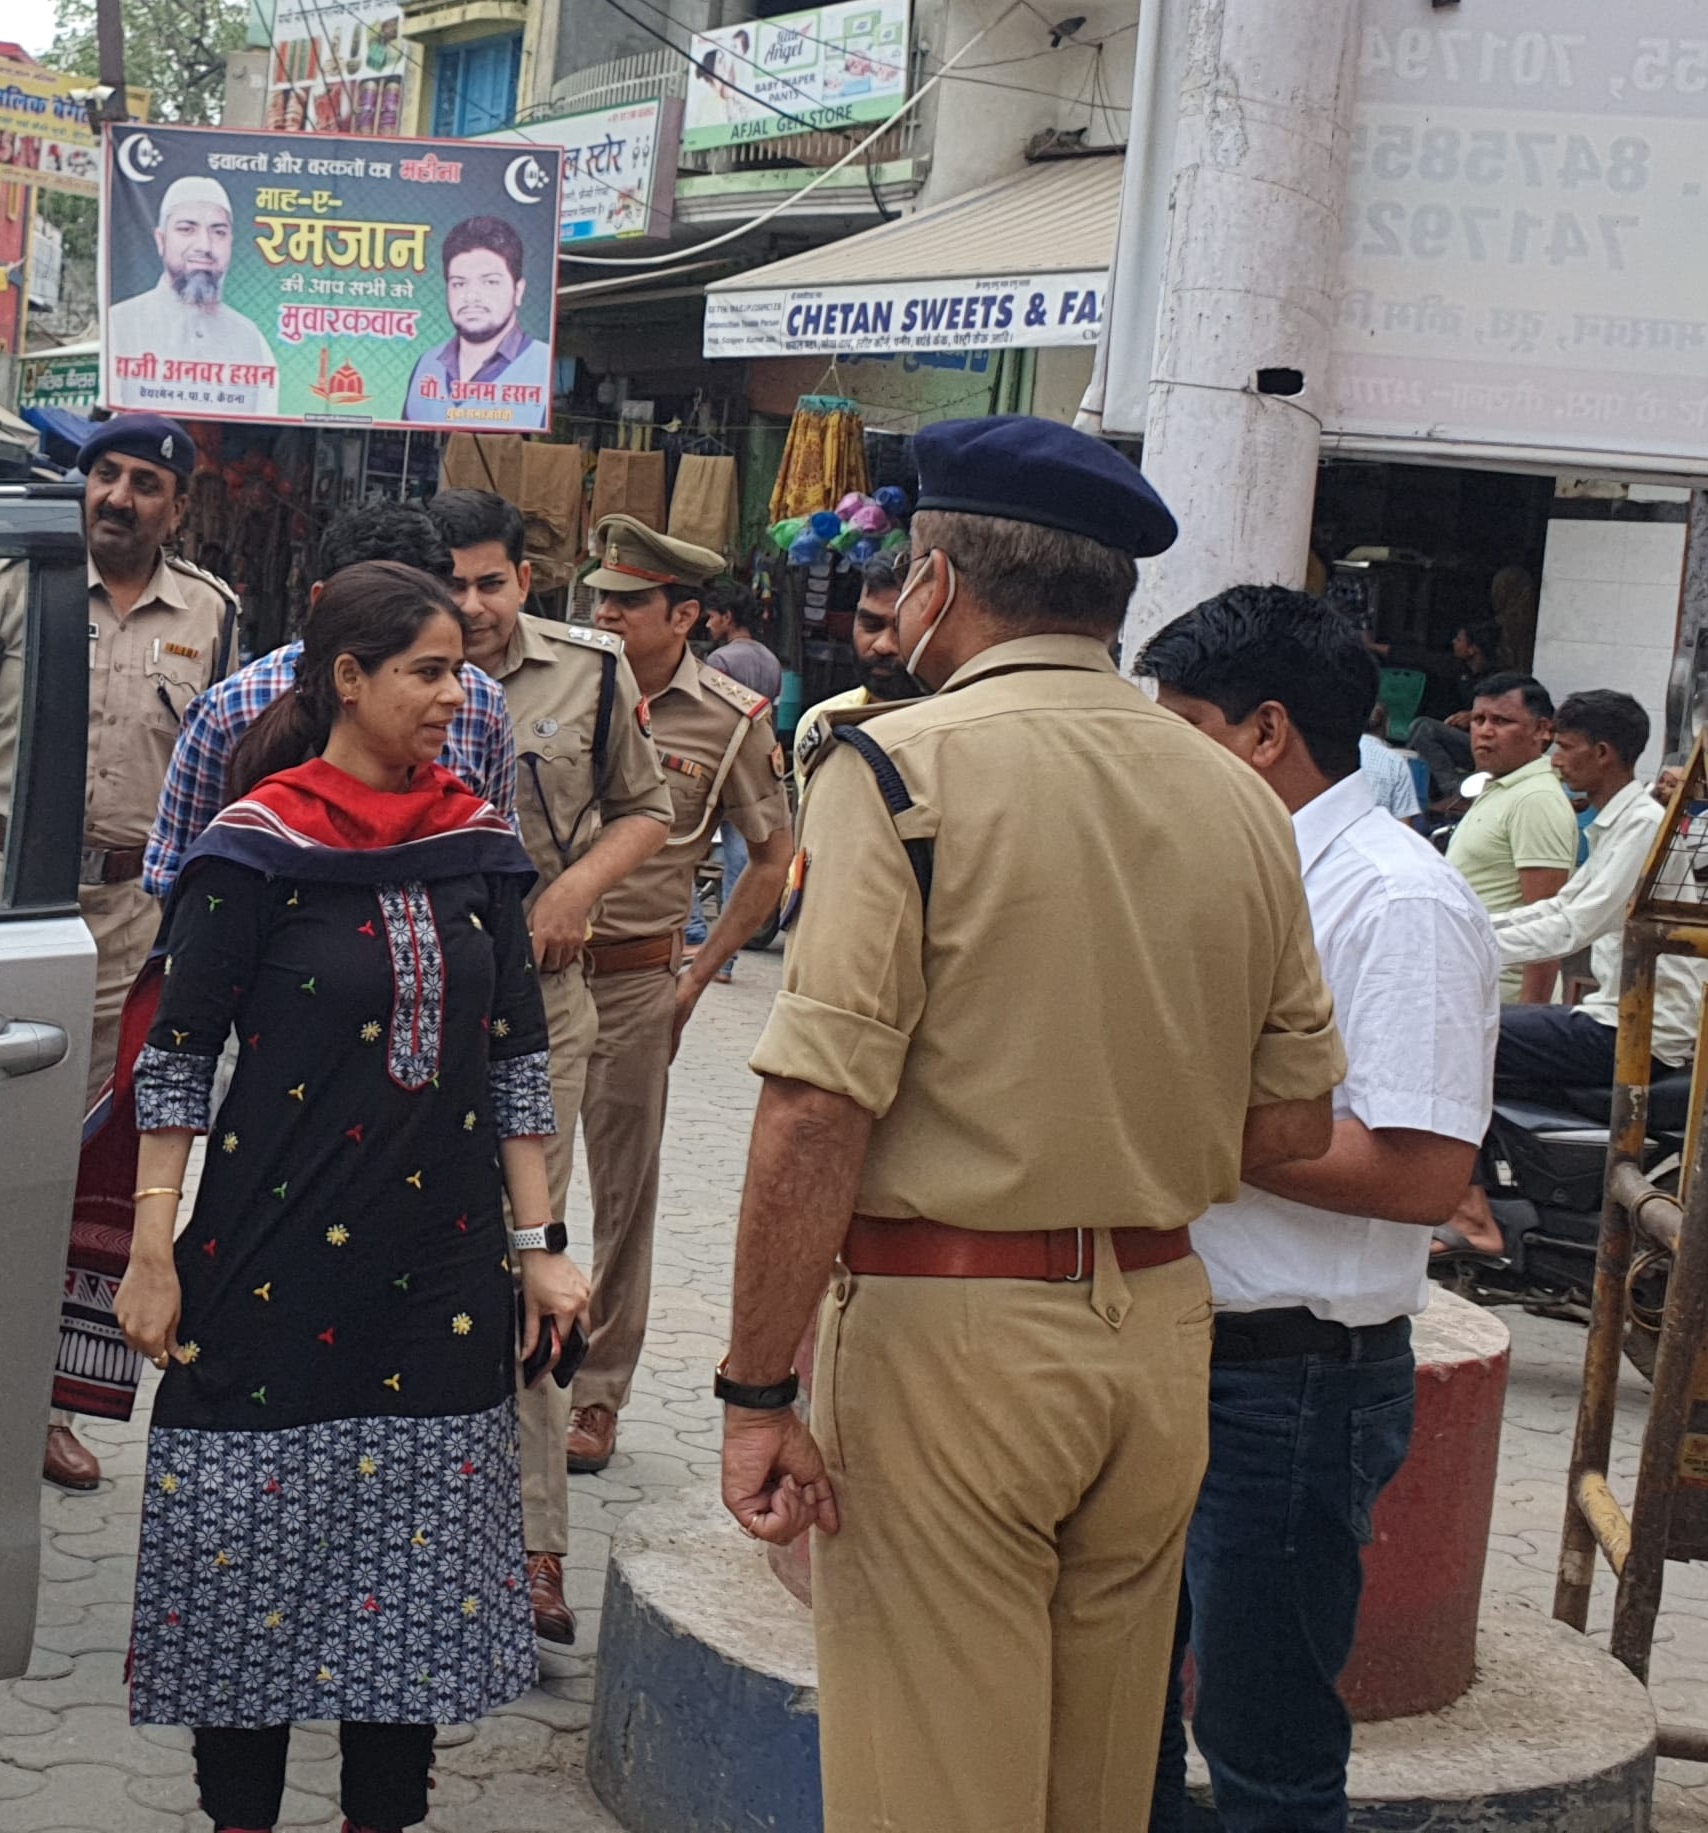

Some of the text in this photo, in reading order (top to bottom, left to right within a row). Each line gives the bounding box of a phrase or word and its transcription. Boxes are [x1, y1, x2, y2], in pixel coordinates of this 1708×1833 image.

[754, 73, 816, 93] BABY DIAPER
[768, 89, 800, 102] PANTS
[730, 105, 853, 140] AFJAL GEN STORE
[273, 151, 302, 175] और
[369, 162, 391, 179] का
[399, 154, 463, 183] महीना
[586, 133, 627, 178] स्टोर
[254, 216, 432, 274] रमजान
[280, 273, 414, 298] की आप सभी को
[787, 301, 893, 337] CHETAN
[901, 294, 1015, 332] SWEETS
[1024, 292, 1047, 327] &
[163, 360, 225, 384] अनवर
[229, 364, 277, 388] हसन
[451, 380, 497, 403] अनम
[502, 384, 542, 406] हसन
